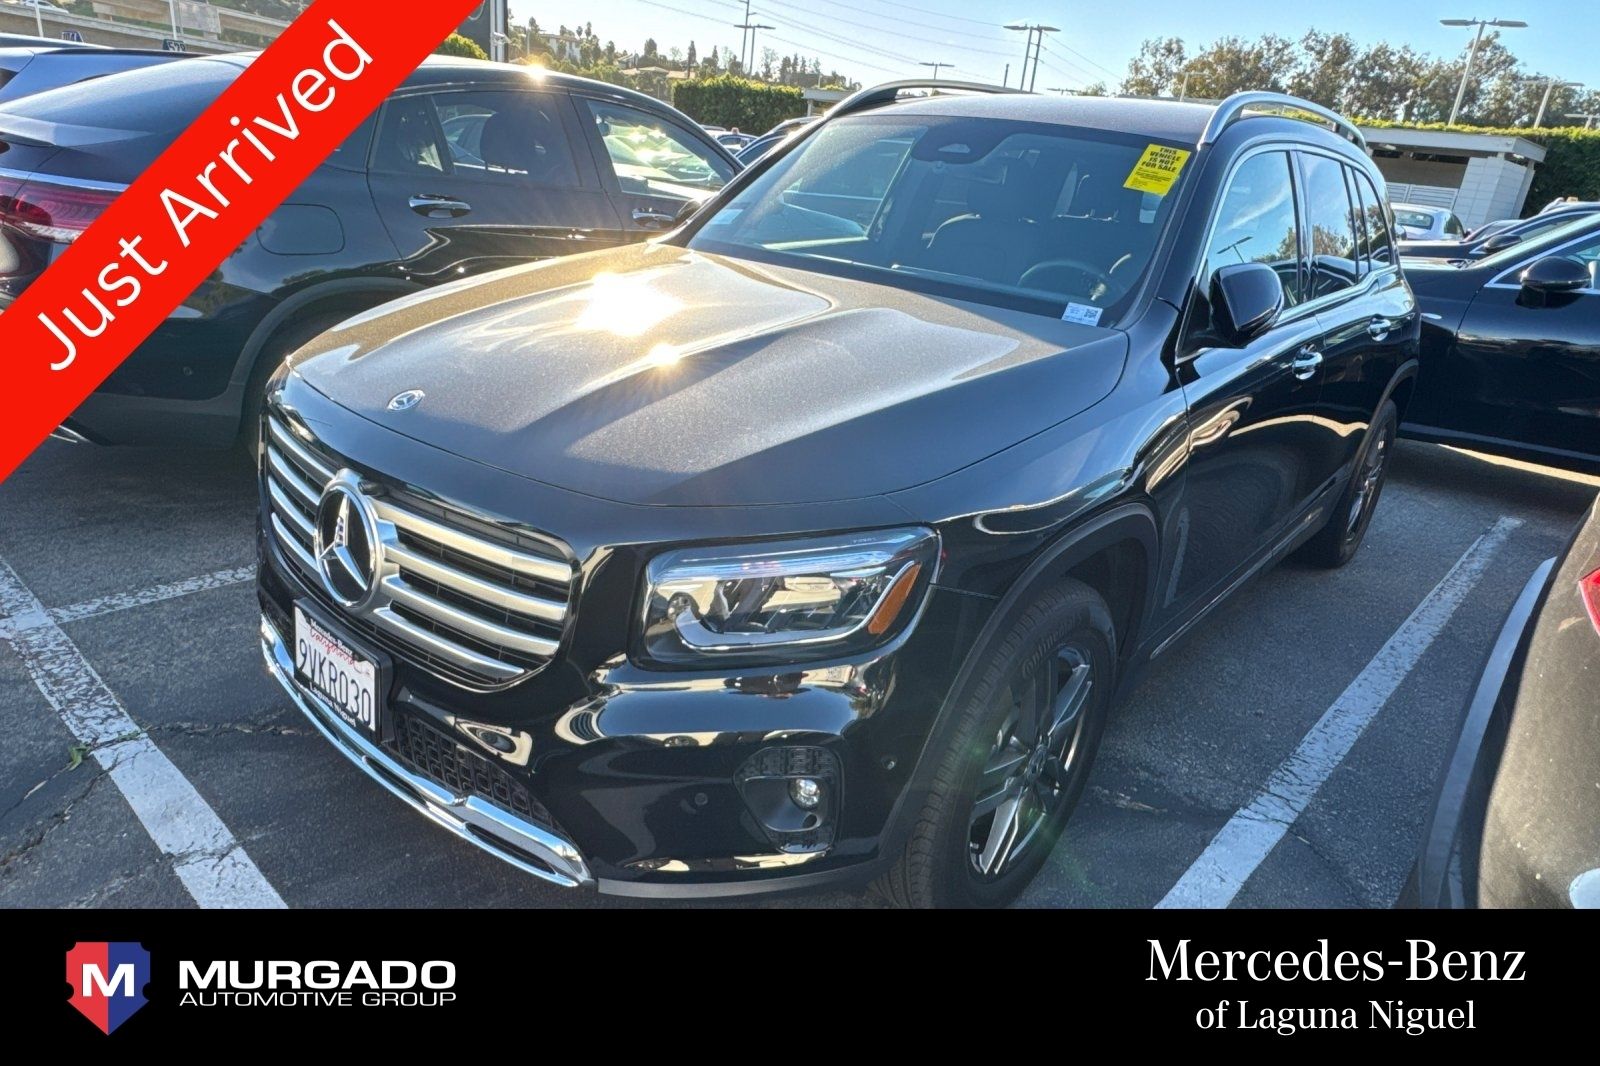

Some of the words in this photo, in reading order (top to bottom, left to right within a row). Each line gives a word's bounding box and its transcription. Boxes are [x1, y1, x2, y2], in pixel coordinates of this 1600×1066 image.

[1149, 151, 1182, 161] VEHICLE
[1159, 147, 1178, 155] THIS
[1141, 161, 1157, 169] FOR
[1157, 163, 1178, 172] SALE
[1159, 158, 1175, 166] NOT
[299, 638, 372, 726] 9VKR030
[309, 681, 334, 707] Laguna
[333, 702, 357, 728] Niguel
